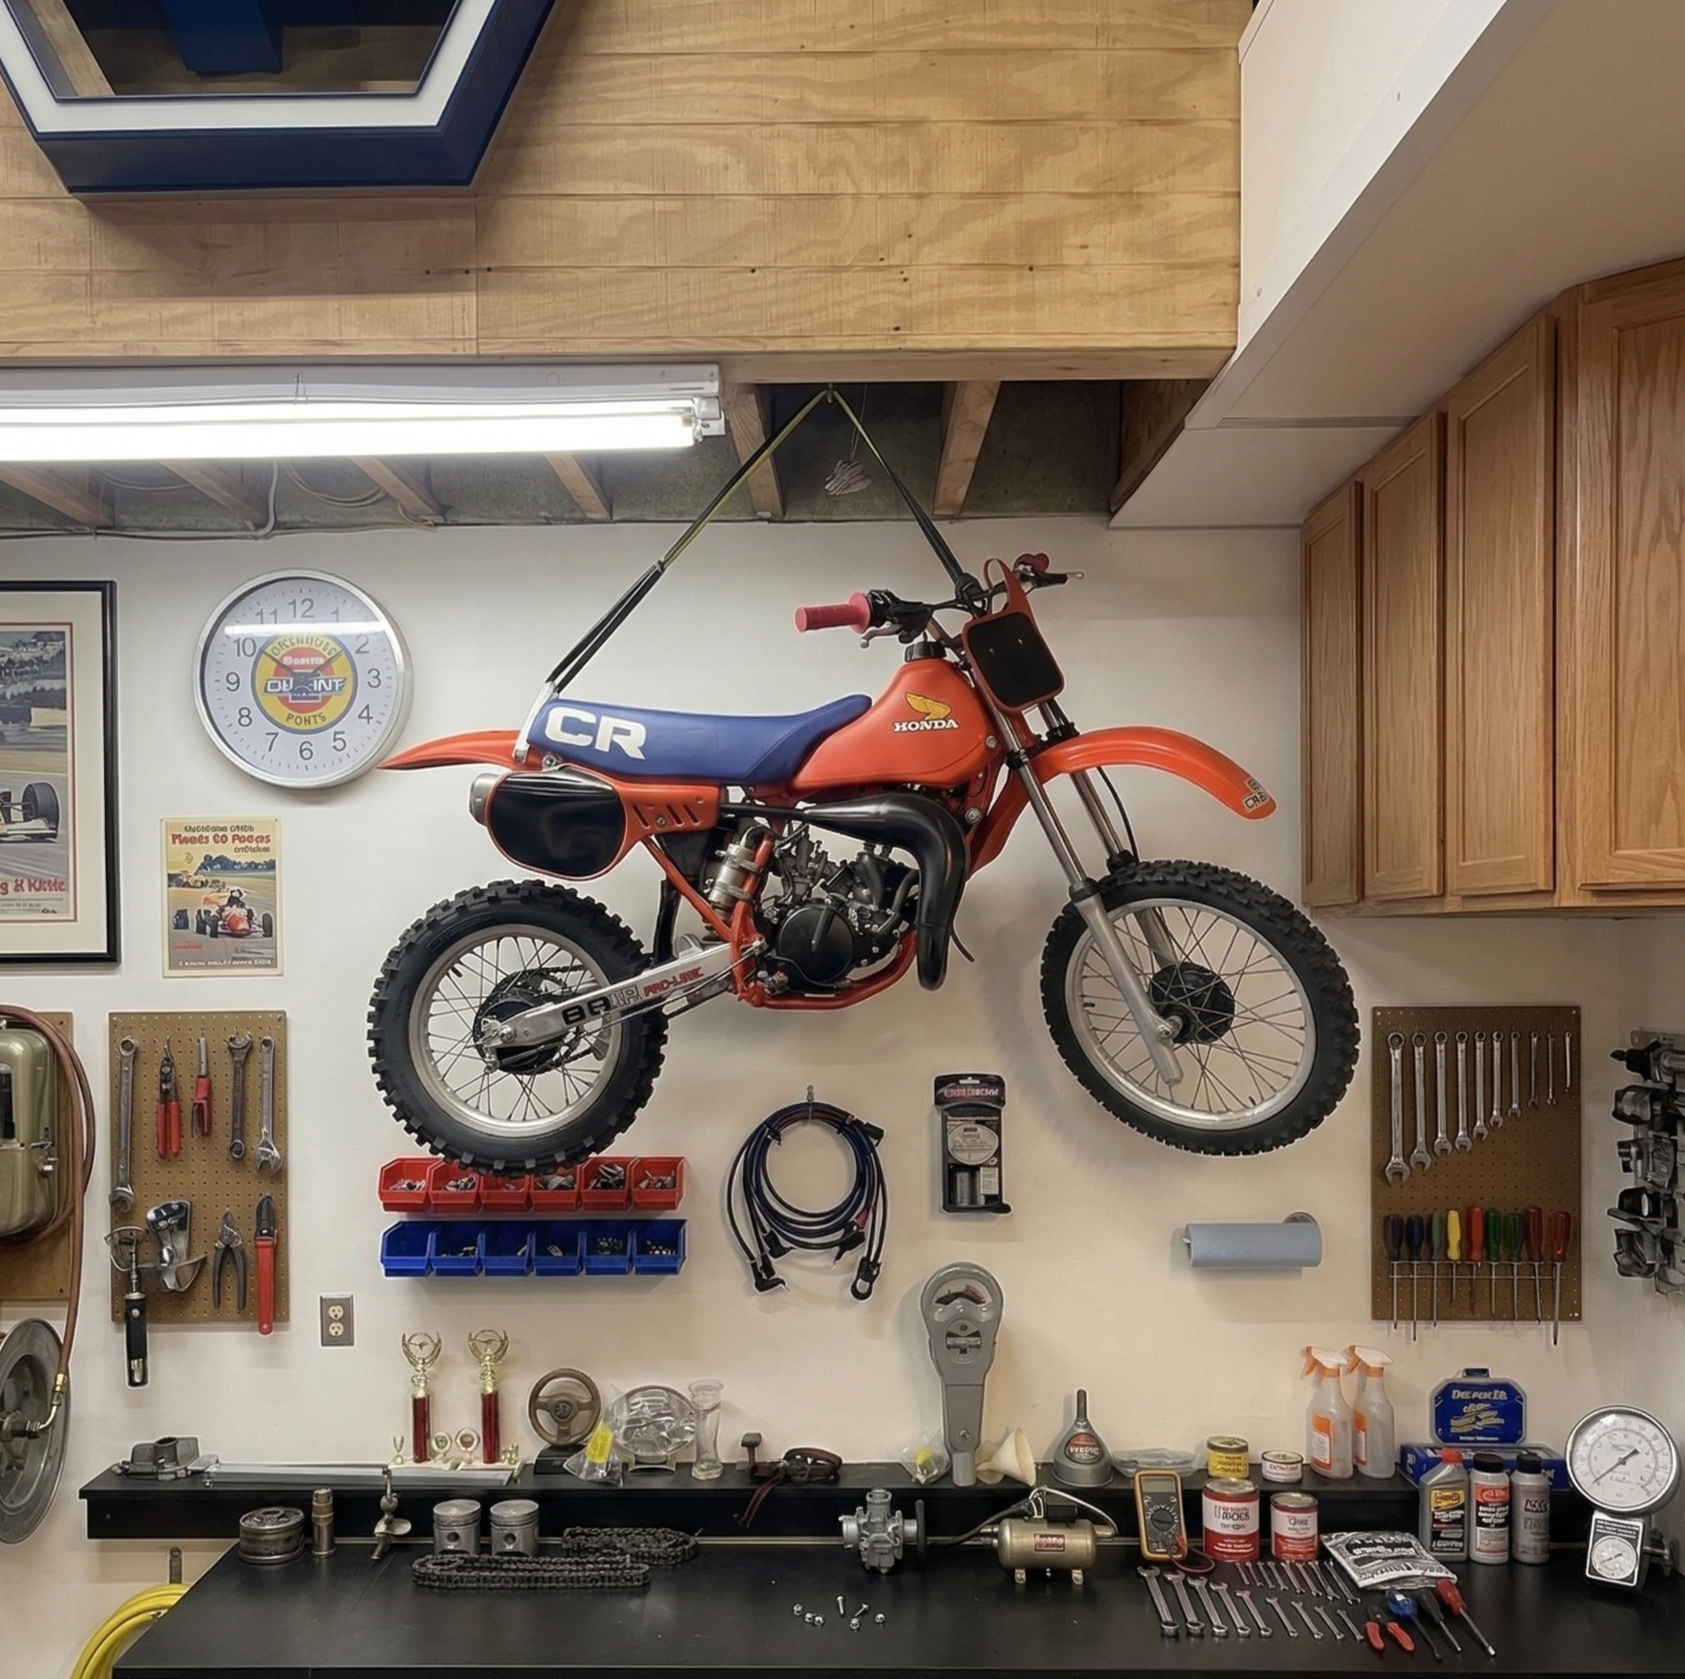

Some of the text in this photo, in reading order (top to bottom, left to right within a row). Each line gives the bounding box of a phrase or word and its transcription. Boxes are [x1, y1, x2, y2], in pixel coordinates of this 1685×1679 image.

[255, 608, 279, 624] 11
[288, 598, 315, 619] 12
[330, 607, 341, 623] 1
[233, 637, 257, 657] 10
[355, 634, 370, 655] 2
[225, 671, 241, 692] 9
[367, 668, 382, 689] 3
[237, 706, 253, 728] 8
[357, 704, 374, 725] 4
[544, 706, 647, 760] CR
[892, 718, 959, 734] HONDA
[265, 732, 280, 752] 7
[299, 740, 314, 761] 6
[332, 731, 347, 752] 5
